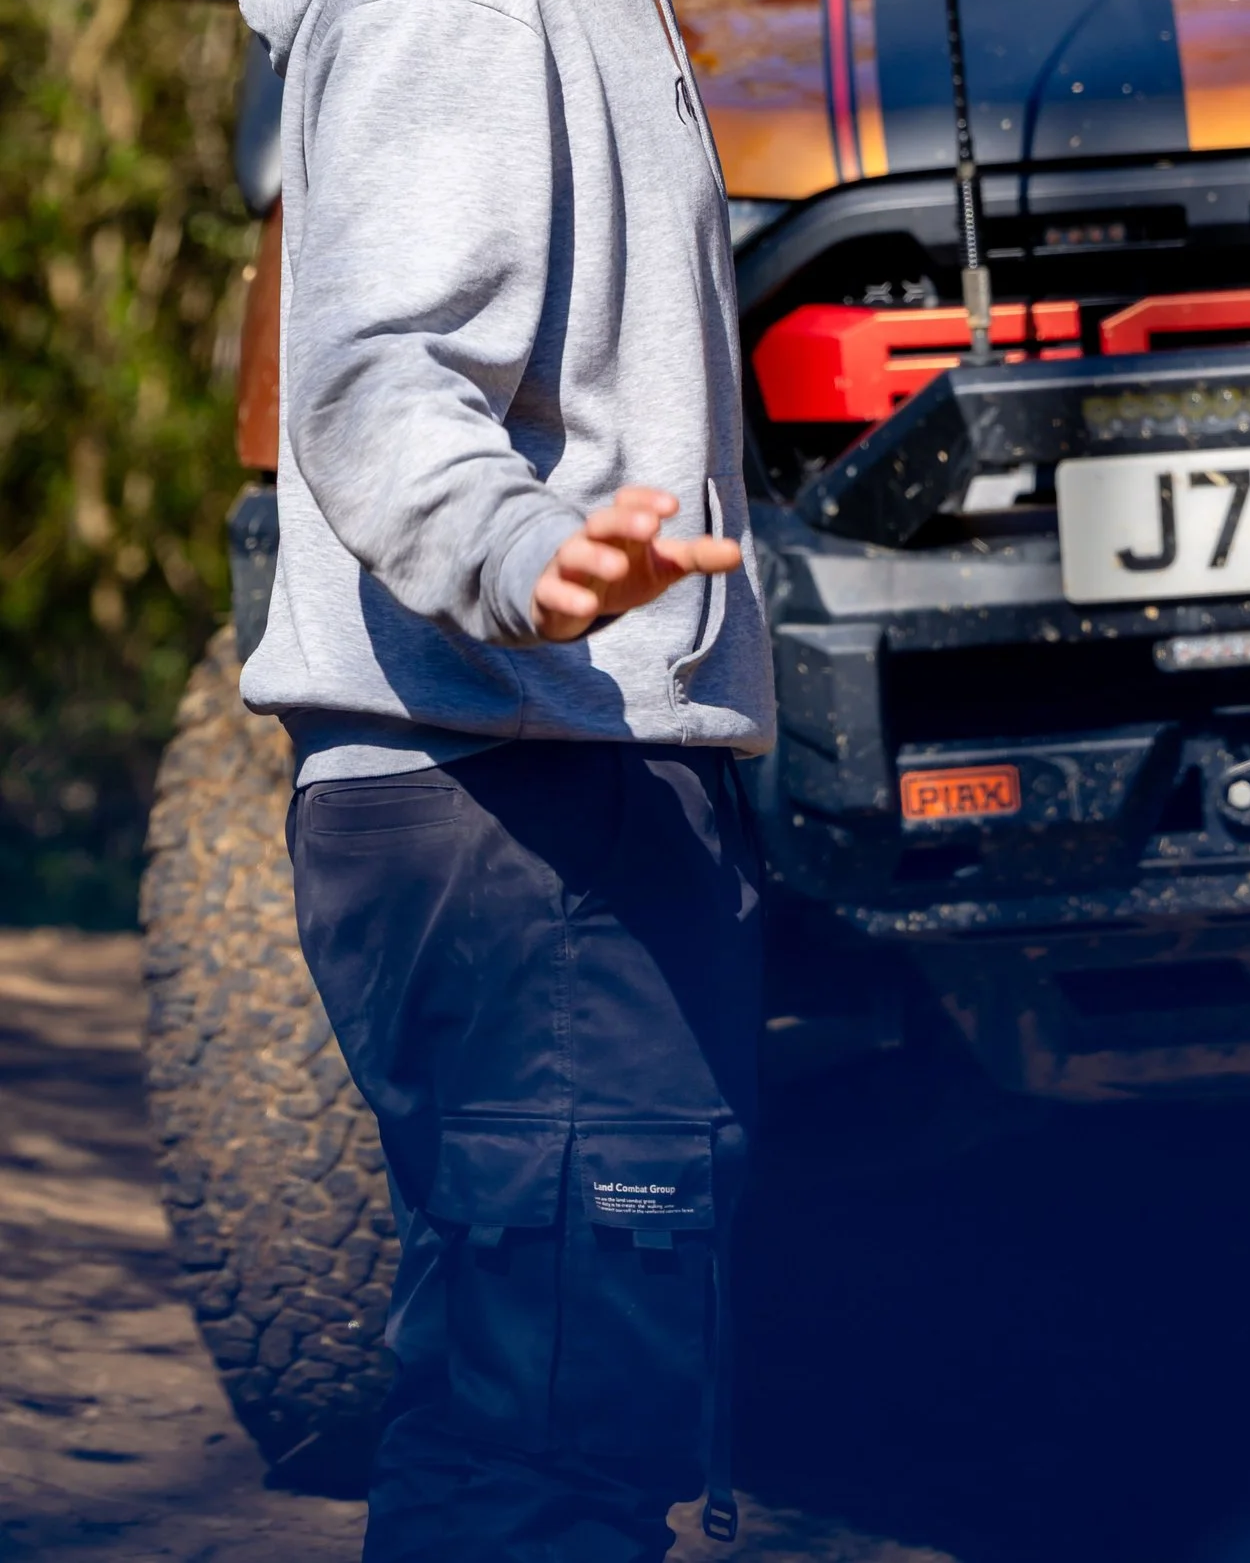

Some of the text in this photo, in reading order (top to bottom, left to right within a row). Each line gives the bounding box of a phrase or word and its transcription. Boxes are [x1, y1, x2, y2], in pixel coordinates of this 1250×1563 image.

[593, 1181, 676, 1195] Land Combat Group
